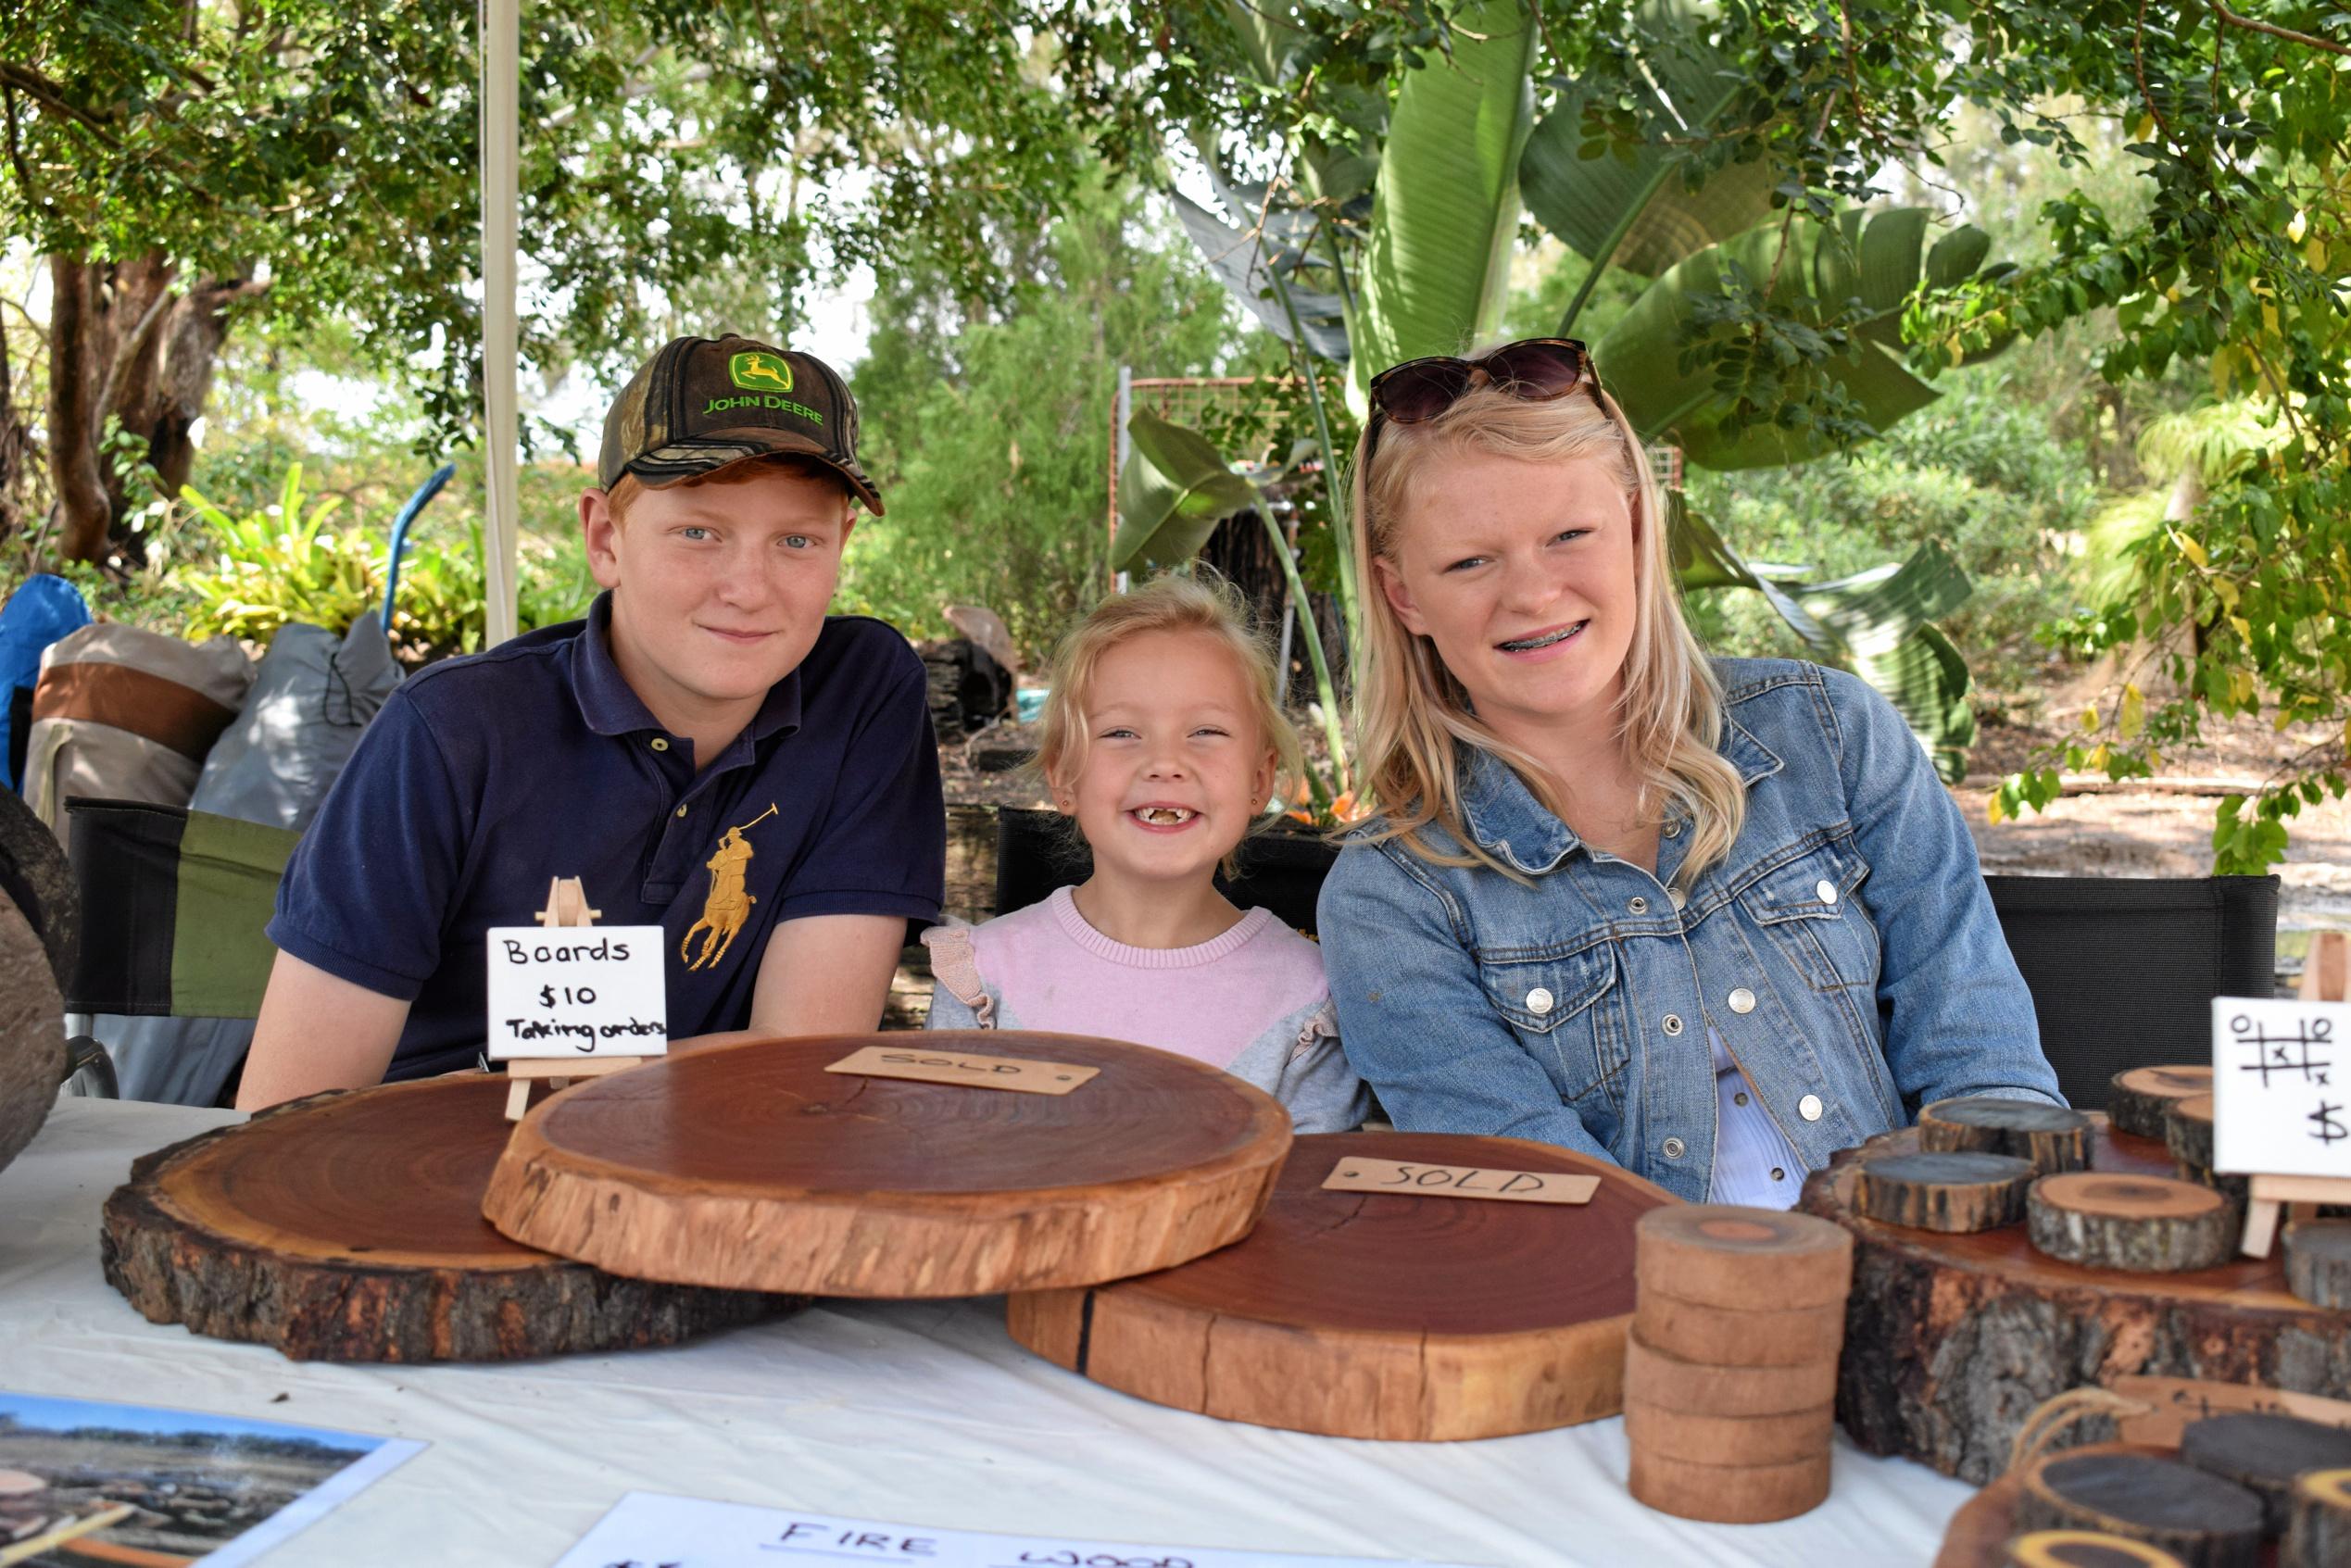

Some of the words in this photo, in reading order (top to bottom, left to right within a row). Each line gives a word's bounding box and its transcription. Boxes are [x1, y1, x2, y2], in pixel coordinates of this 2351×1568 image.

[702, 395, 761, 416] JOHN
[763, 395, 823, 427] DEERE
[503, 936, 631, 965] Boards
[538, 984, 597, 1010] $10
[505, 1019, 596, 1053] Taking
[880, 1053, 1022, 1075] SOLD
[1379, 1165, 1545, 1194] SOLD
[779, 1521, 937, 1558] FIRE
